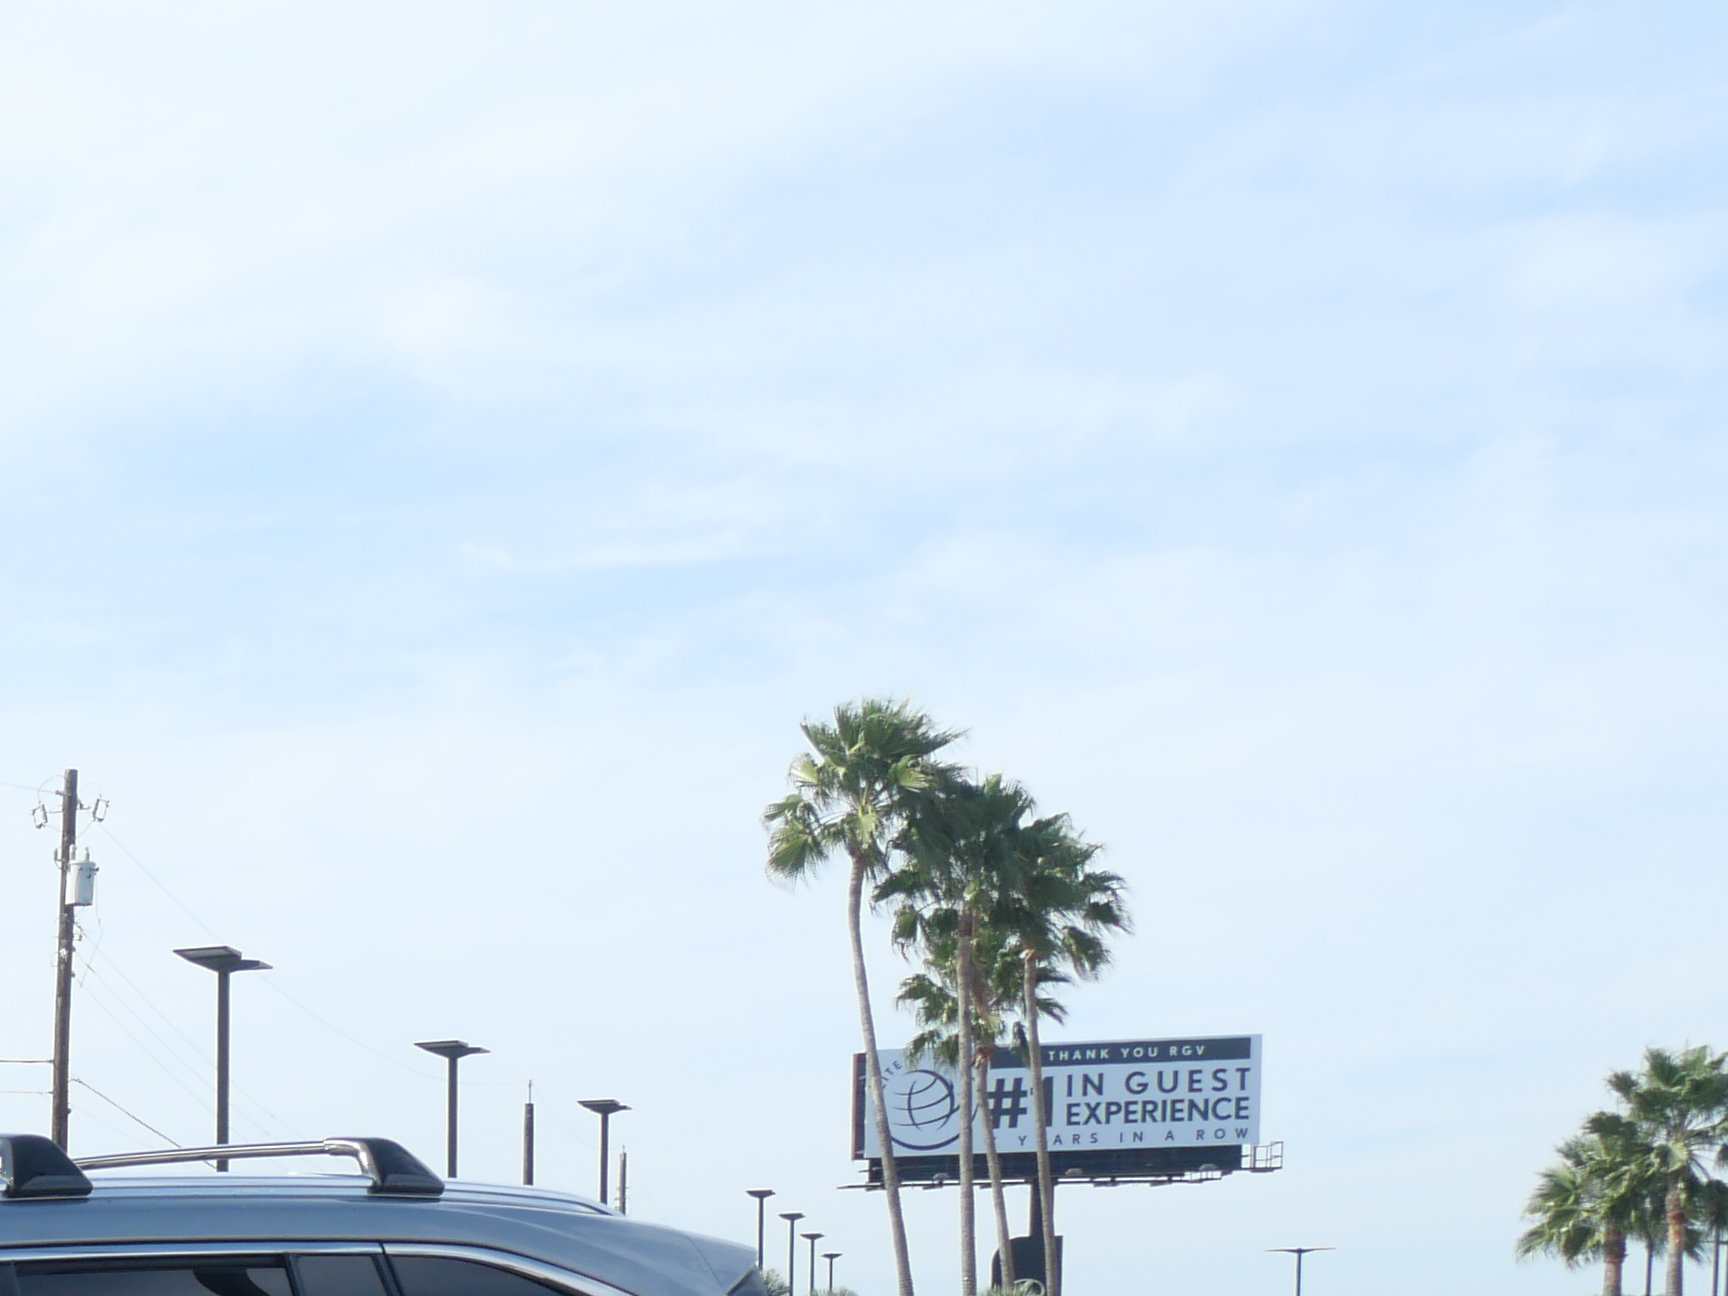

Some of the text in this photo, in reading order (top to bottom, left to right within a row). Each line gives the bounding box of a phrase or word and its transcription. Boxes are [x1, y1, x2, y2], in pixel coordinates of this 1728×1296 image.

[1048, 1045, 1206, 1062] THANK YOU RGV
[1066, 1072, 1104, 1098] IN
[1124, 1067, 1251, 1095] GUEST
[1066, 1096, 1250, 1127] EXPERIENCE
[1018, 1127, 1248, 1147] YARS IN A ROW
